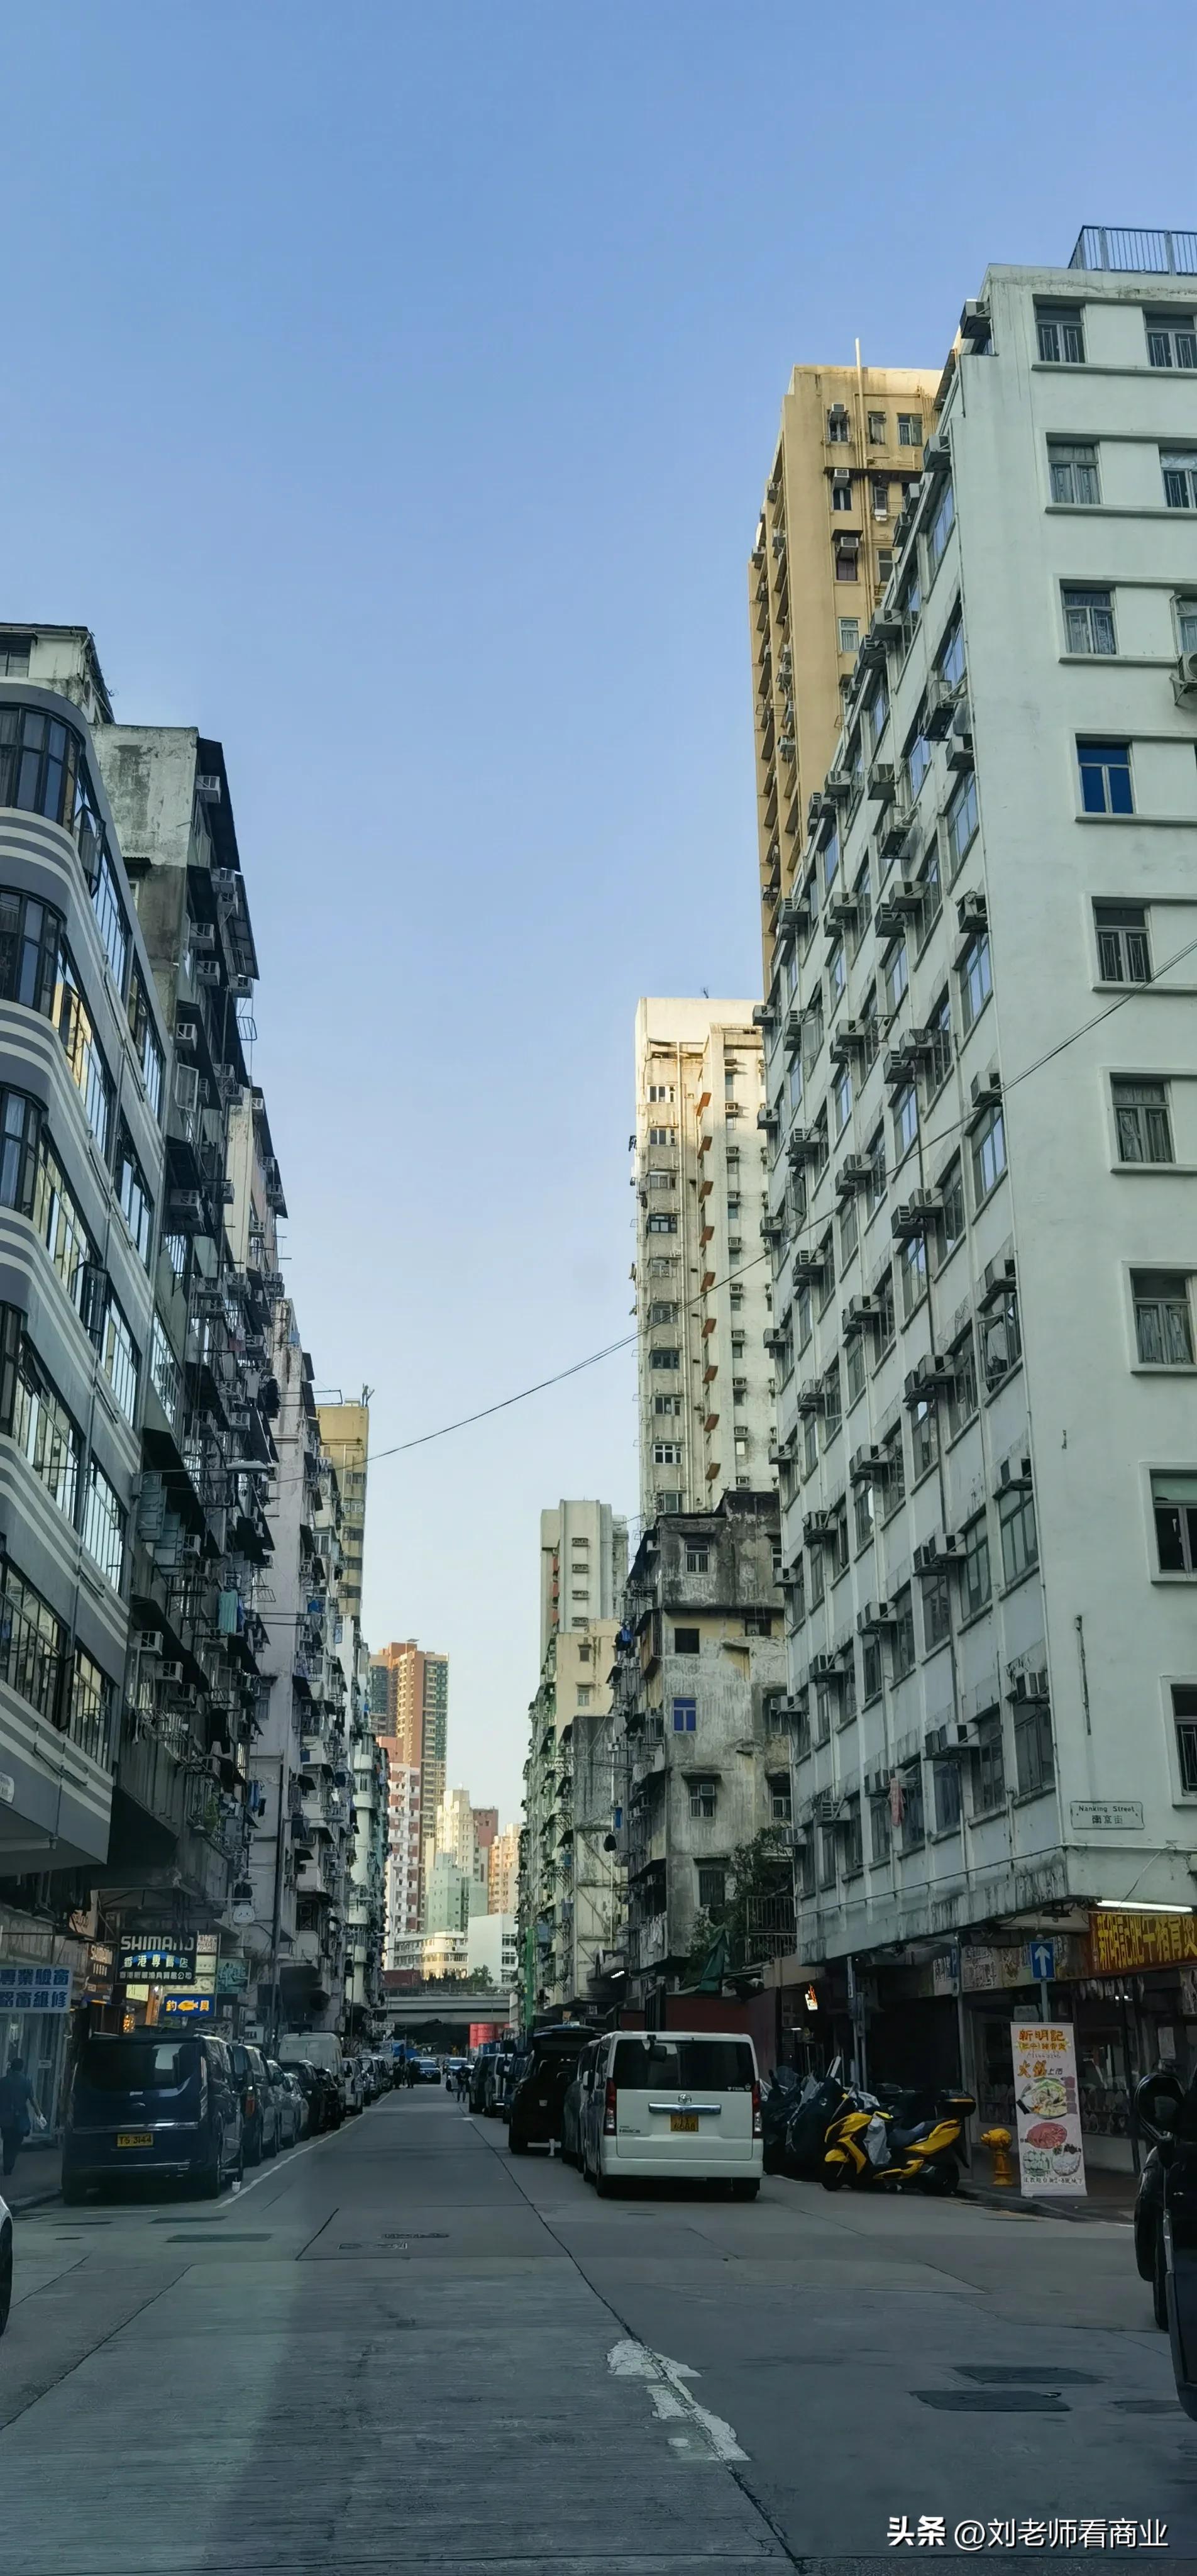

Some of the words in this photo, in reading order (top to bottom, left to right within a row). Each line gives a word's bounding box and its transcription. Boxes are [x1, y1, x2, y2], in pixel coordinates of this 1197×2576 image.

[1078, 1805, 1108, 1813] Nanking
[1091, 1814, 1123, 1824] 南京街
[1019, 2029, 1065, 2041] 新明記
